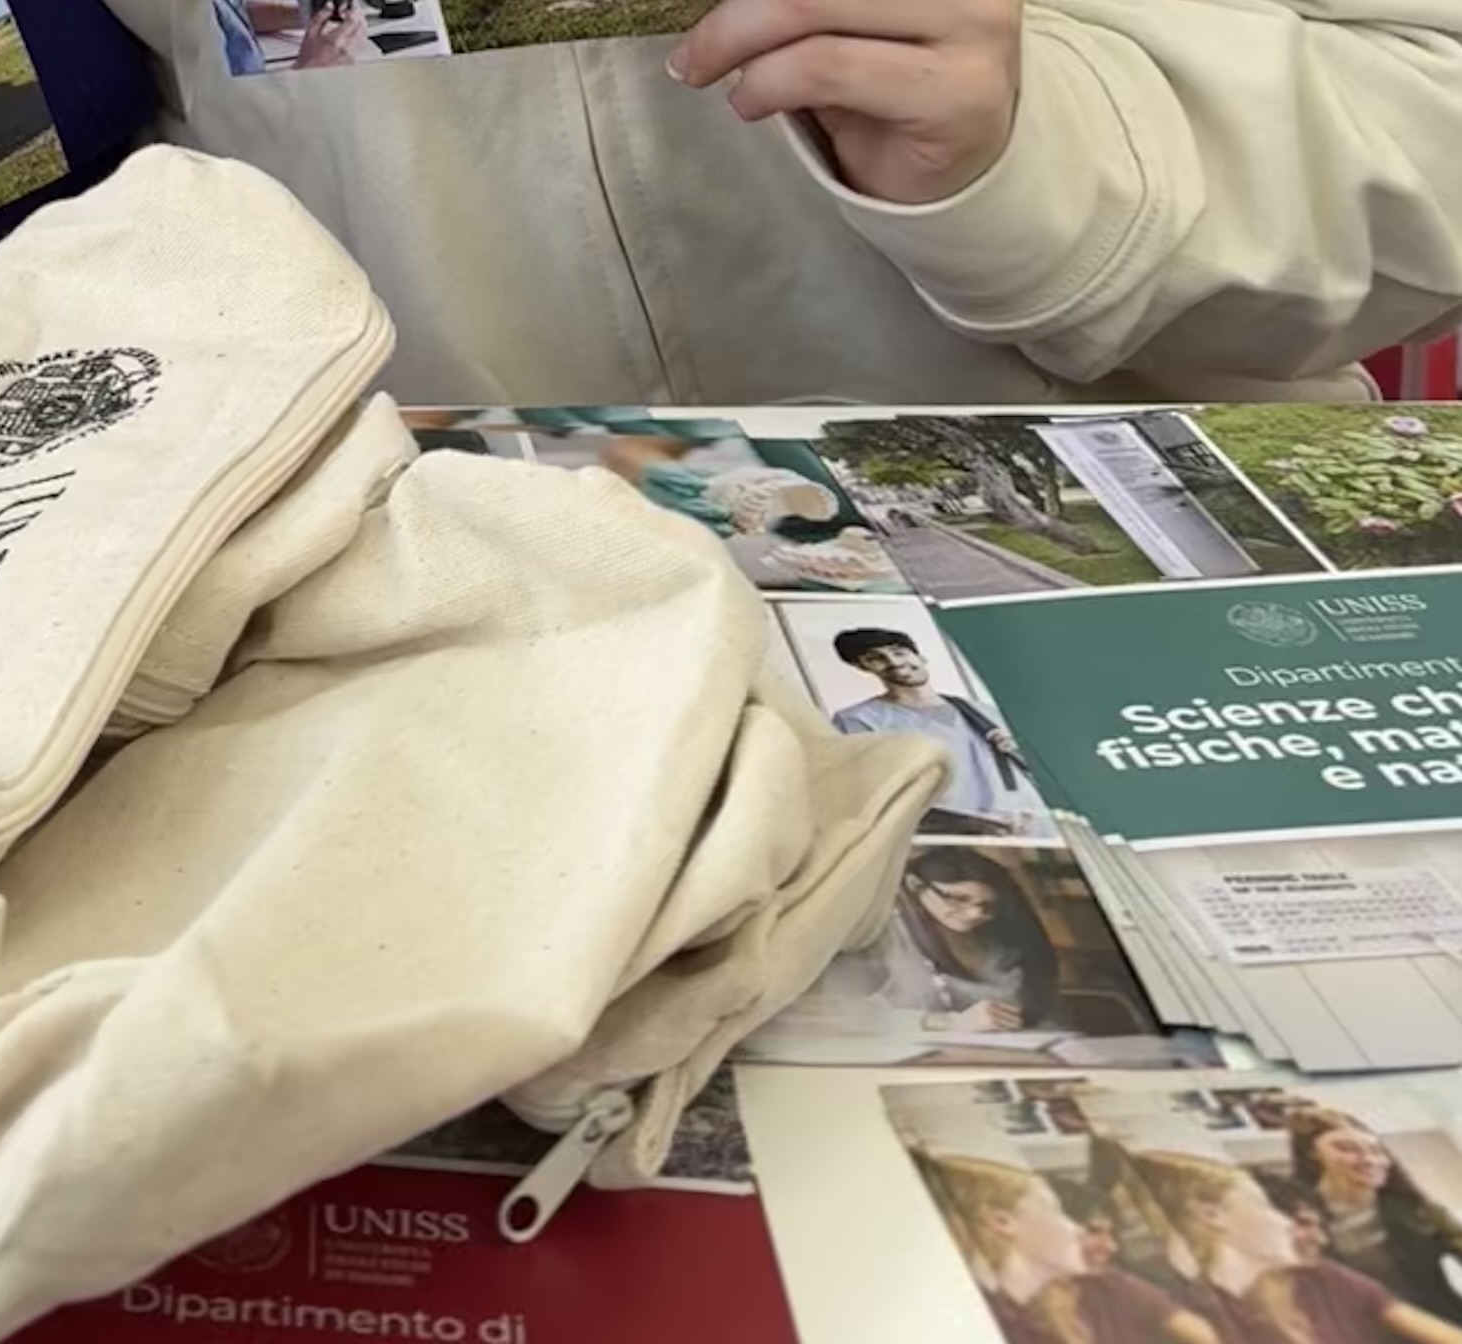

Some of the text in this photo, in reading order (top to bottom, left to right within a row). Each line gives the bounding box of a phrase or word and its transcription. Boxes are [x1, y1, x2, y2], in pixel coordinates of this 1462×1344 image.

[1317, 593, 1428, 616] UNISS
[1120, 681, 1462, 734] Scienze ch
[1095, 730, 1345, 771] fisiche,
[1320, 753, 1462, 791] e na
[322, 1203, 471, 1243] UNISS
[121, 1280, 527, 1344] Dipartimento di
